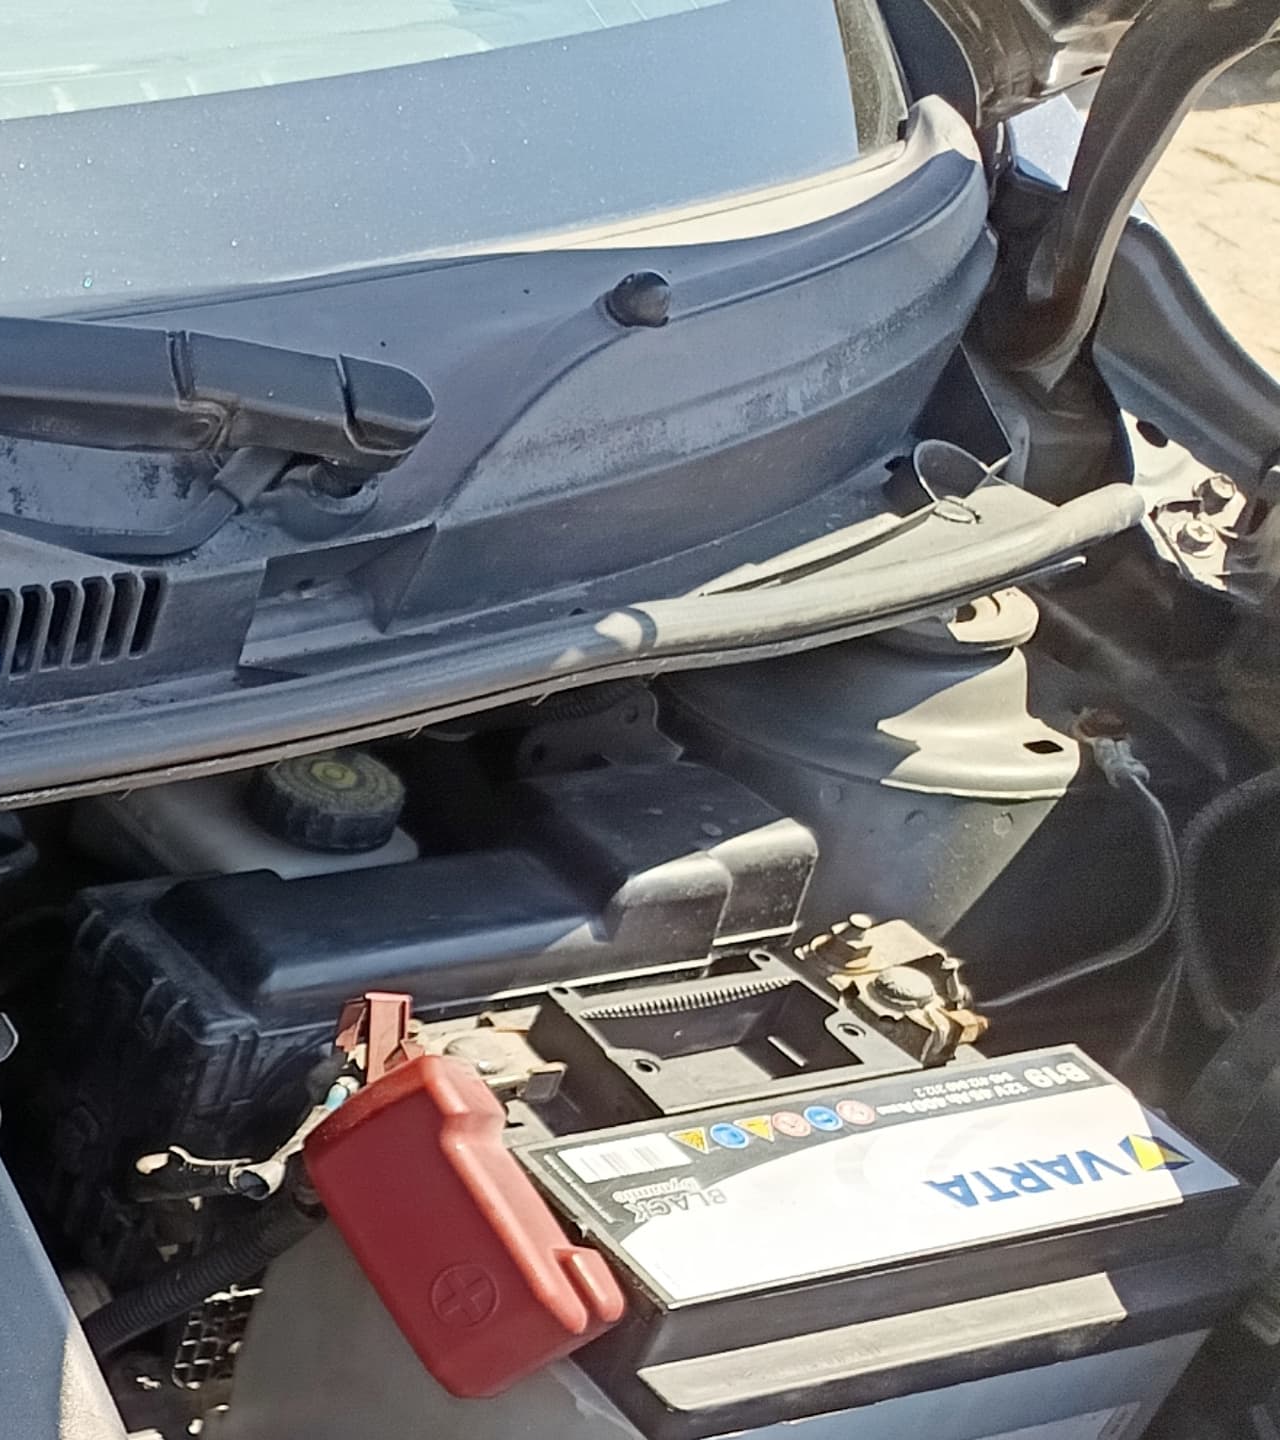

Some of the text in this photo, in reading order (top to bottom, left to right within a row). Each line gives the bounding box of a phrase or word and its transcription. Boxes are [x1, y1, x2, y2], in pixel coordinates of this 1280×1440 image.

[994, 1081, 1030, 1099] 12V
[1023, 1060, 1090, 1090] B19
[923, 1149, 1131, 1208] VARTA
[621, 1186, 728, 1226] BLACK
